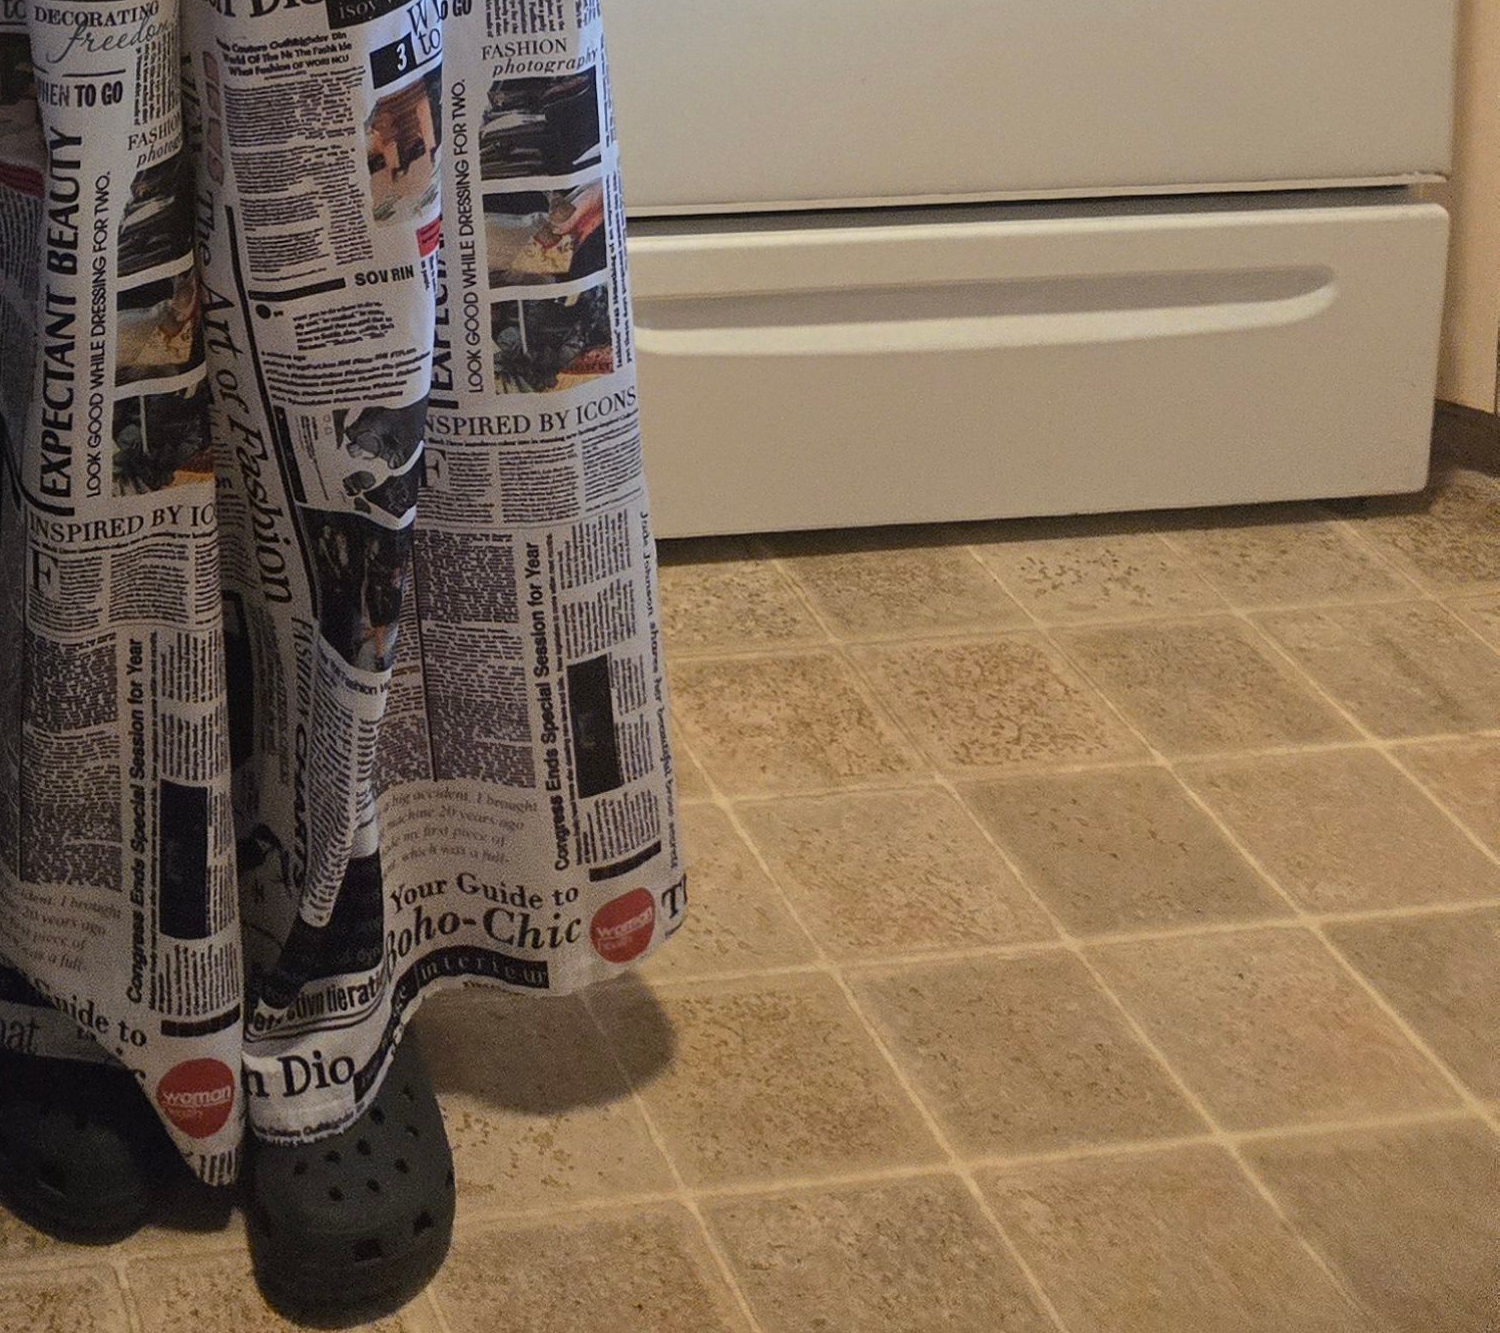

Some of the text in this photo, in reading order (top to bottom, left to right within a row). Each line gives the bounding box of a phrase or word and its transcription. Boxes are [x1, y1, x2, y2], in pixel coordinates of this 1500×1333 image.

[396, 42, 407, 71] 3
[481, 38, 568, 62] FASHION
[492, 46, 598, 78] photography
[75, 84, 96, 107] TO
[101, 81, 123, 105] GO
[93, 217, 109, 253] FOR
[451, 78, 484, 393] LOOK GOOD WHILE DRESSING FOR TWO.
[90, 255, 108, 337] DRESSING
[355, 264, 415, 287] SOV RIN
[40, 126, 82, 498] EXPECTANT BEAUTY
[201, 286, 242, 358] Art
[89, 339, 106, 391] WHILE
[216, 370, 250, 414] of
[426, 385, 638, 437] NSPIRED BY ICONS
[88, 393, 104, 449] GOOD
[87, 452, 101, 498] LOOK
[30, 504, 183, 543] INSPIRED BY
[226, 416, 294, 605] Fashion
[524, 541, 570, 872] Congress Ends Special Session for Year
[125, 638, 147, 1004] Congress Ends Special Session for Year
[389, 872, 579, 915] Your Guide to
[118, 1020, 147, 1049] to
[278, 1050, 356, 1098] Dio
